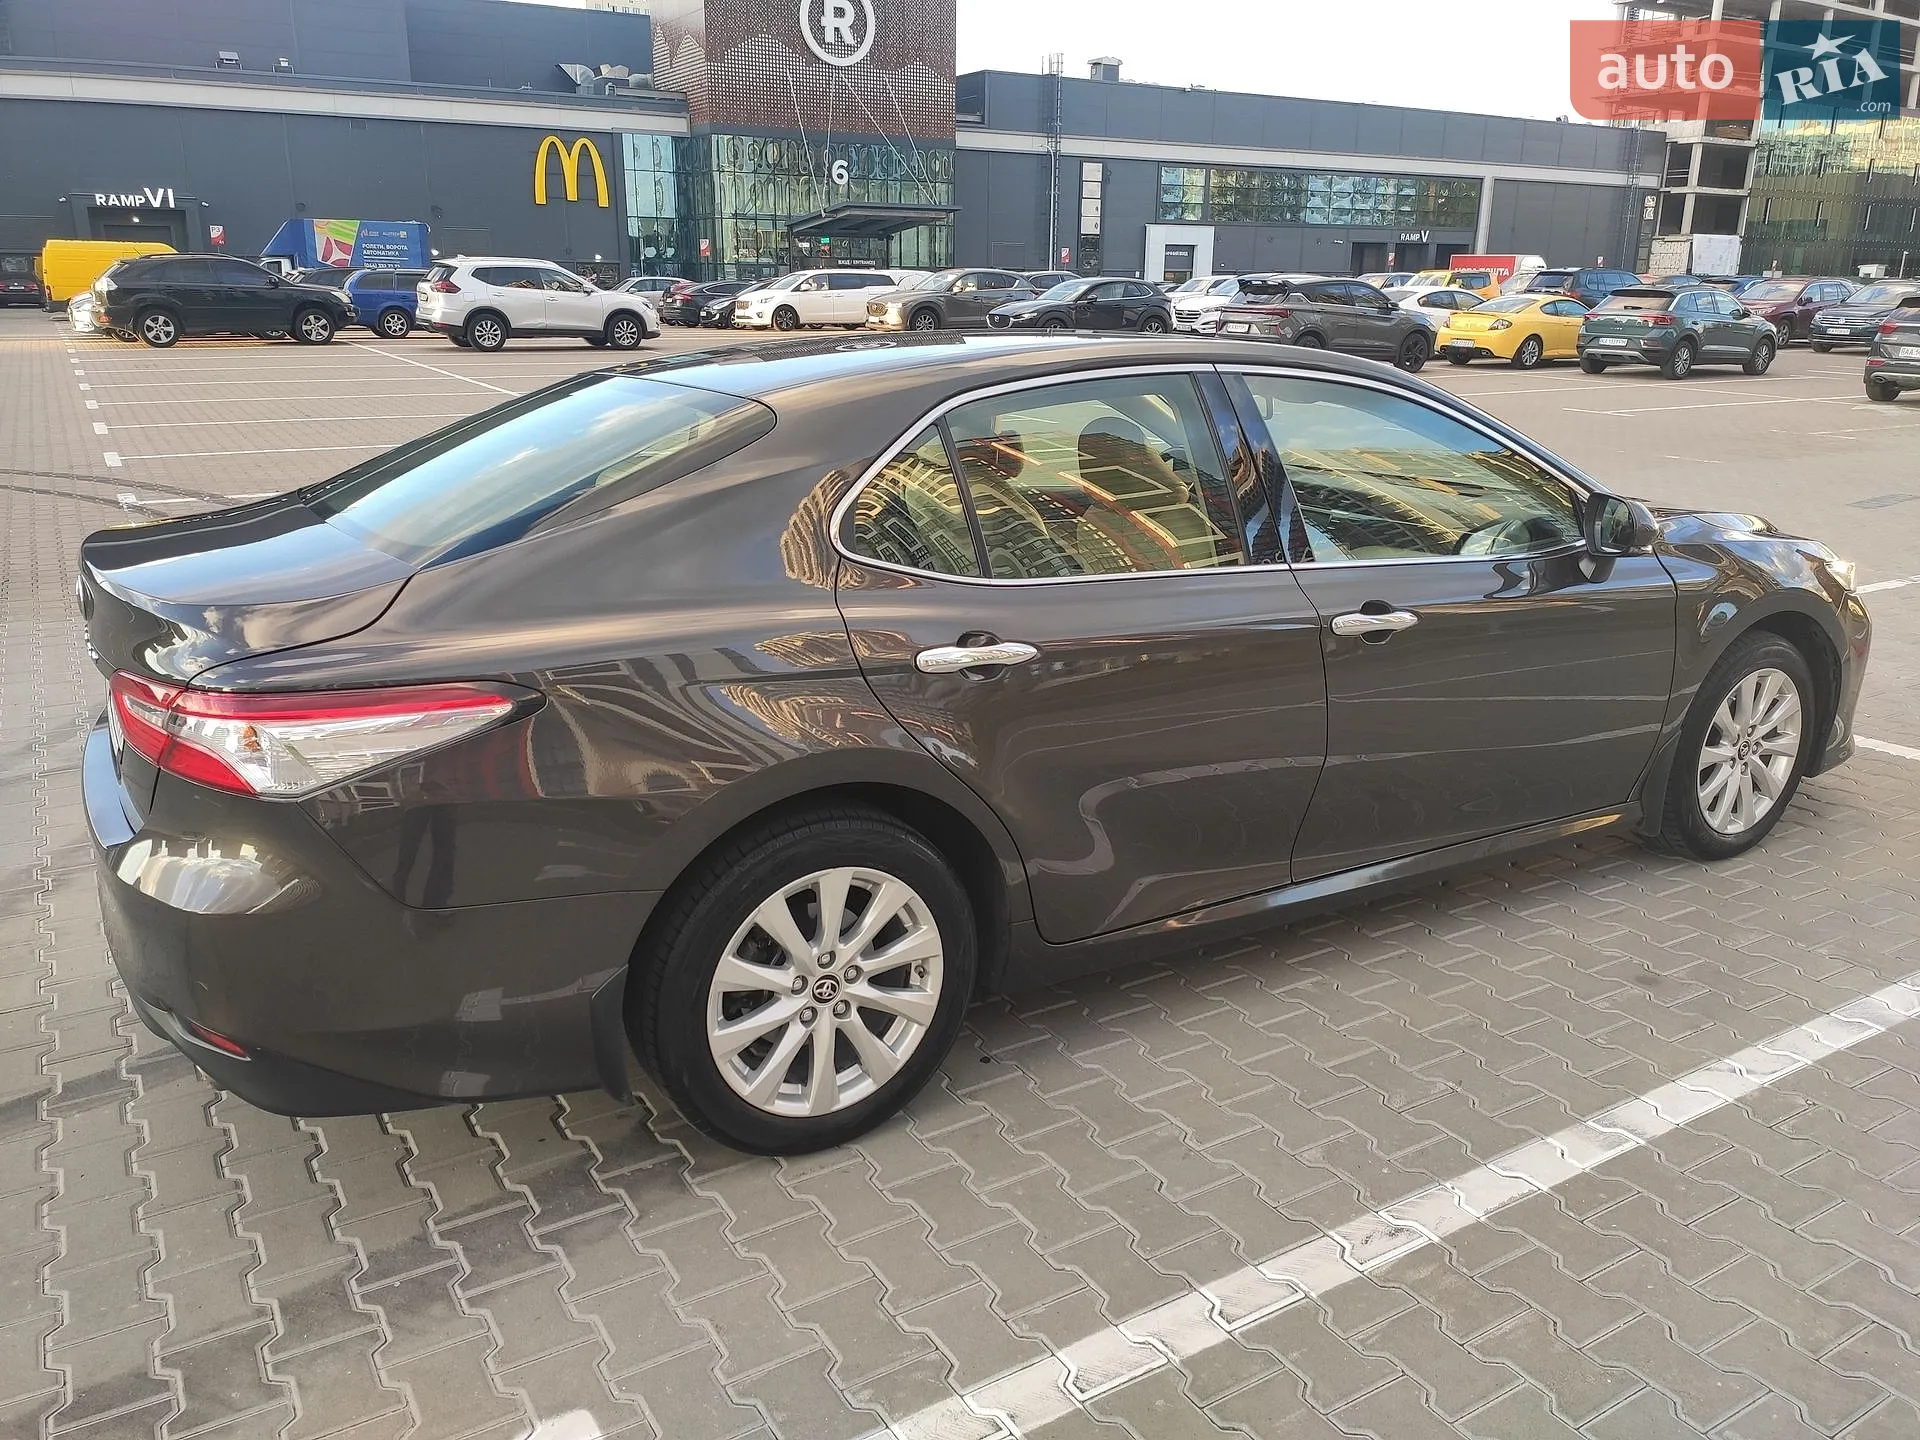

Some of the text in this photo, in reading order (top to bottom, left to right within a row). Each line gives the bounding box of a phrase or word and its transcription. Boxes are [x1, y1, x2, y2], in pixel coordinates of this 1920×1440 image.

[832, 160, 849, 185] 6
[95, 187, 176, 209] RAMP VI
[1400, 230, 1430, 243] RAMP V
